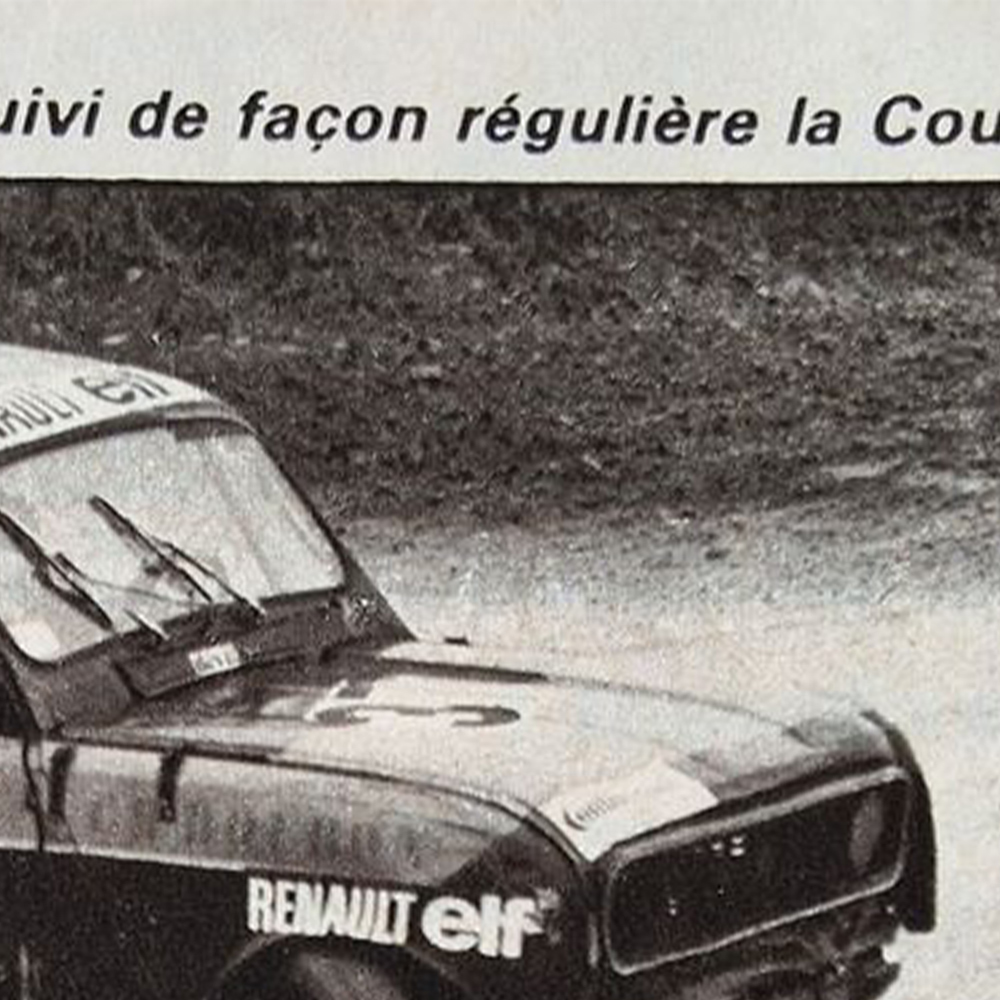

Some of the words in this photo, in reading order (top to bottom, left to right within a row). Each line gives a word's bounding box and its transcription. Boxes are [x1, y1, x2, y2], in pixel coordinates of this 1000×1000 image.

[127, 89, 209, 140] de
[238, 89, 428, 153] façon
[456, 92, 759, 155] régulière
[786, 95, 842, 146] la
[873, 94, 1000, 147] Cou
[247, 876, 419, 946] RENAULT
[420, 894, 546, 959] elf
